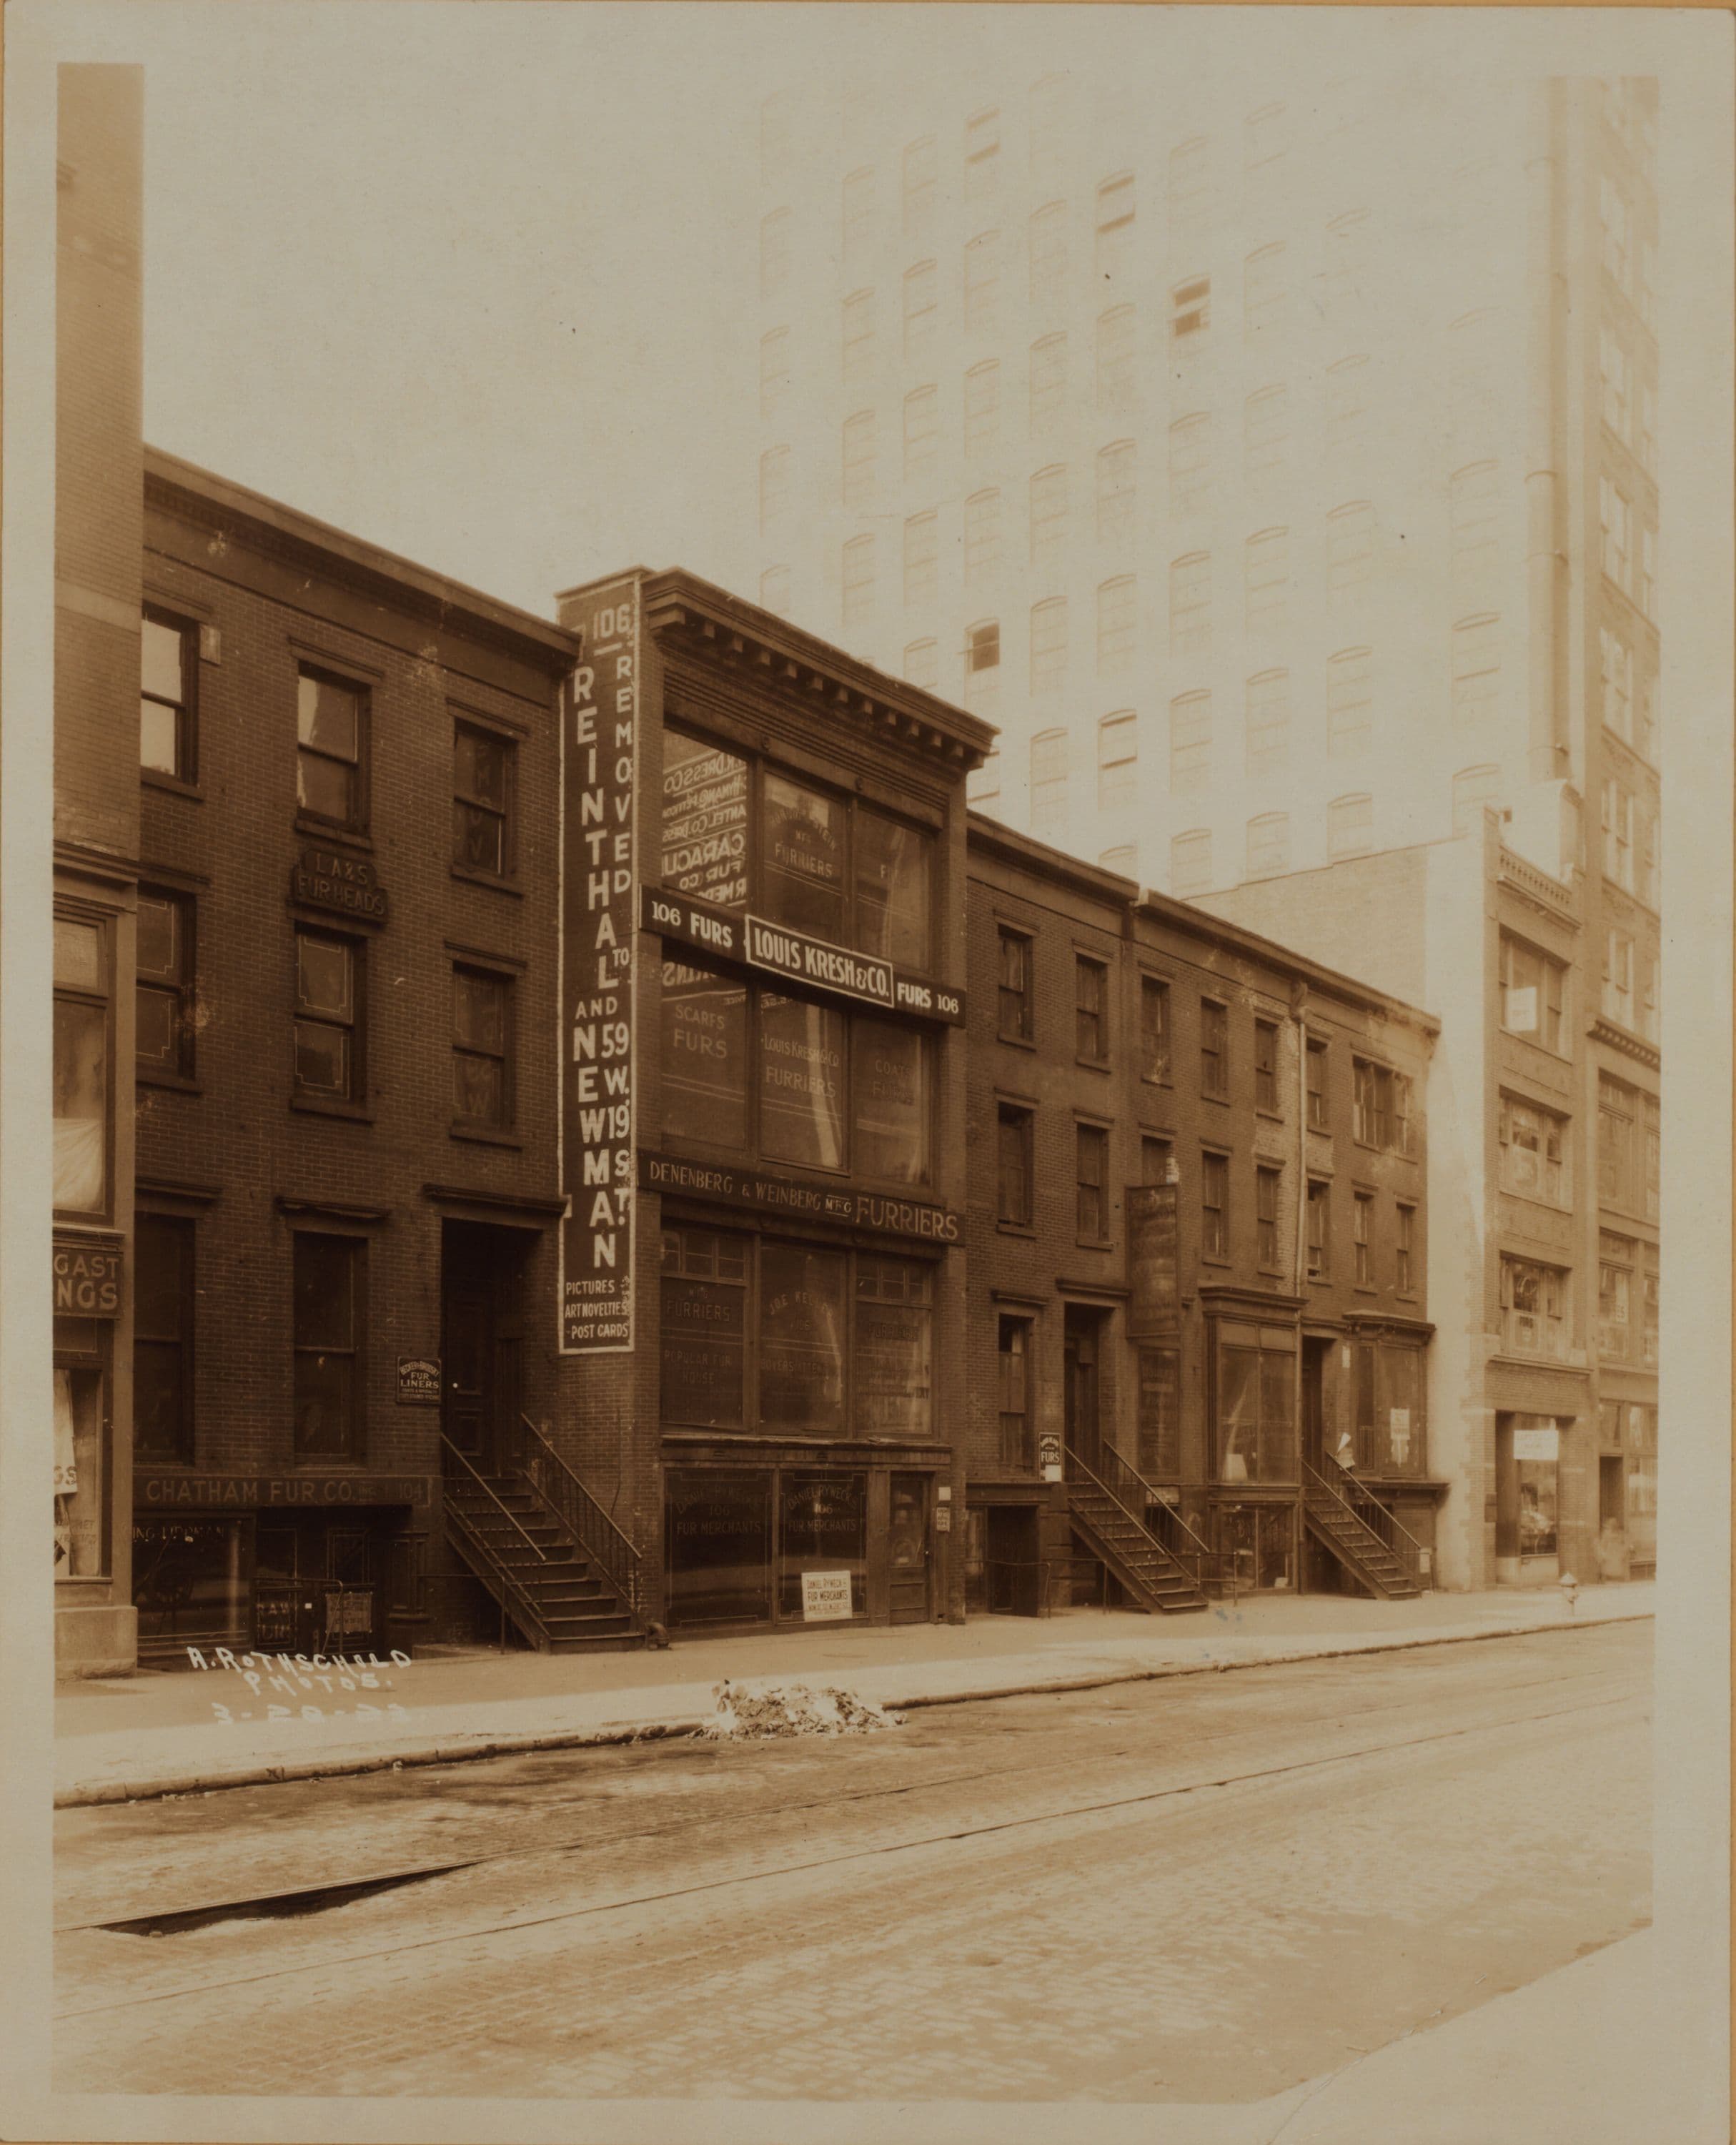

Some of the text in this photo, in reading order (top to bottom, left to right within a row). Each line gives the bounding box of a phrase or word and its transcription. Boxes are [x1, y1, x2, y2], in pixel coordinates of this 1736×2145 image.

[594, 605, 630, 640] 106
[614, 655, 633, 893] REMOVED
[652, 901, 732, 948] 106 FURS
[573, 665, 619, 1268] REINTHAL AND NEWMAN
[612, 947, 629, 967] TO
[755, 927, 800, 970] LOUIS
[805, 946, 855, 987] KRESH
[868, 966, 890, 996] CO.
[898, 981, 959, 1014] FURS 106
[675, 1005, 725, 1031] SCARFS
[602, 1022, 628, 1059] 59
[673, 1029, 728, 1059] FURS
[764, 1033, 790, 1056] LOUIS
[765, 1065, 836, 1098] FURRIERS
[650, 1159, 733, 1194] DENENBERG
[742, 1186, 749, 1197] &
[756, 1182, 820, 1211] WEINBERG
[855, 1196, 958, 1240] FURRIERS
[57, 1279, 118, 1309] NGS
[566, 1279, 615, 1295] PICTURES
[565, 1301, 628, 1319] ART NOVELTIES
[667, 1300, 731, 1321] FURRIERS
[572, 1322, 629, 1339] POST CARDS
[664, 1349, 709, 1365] POPULAR
[400, 1379, 439, 1389] LINERS
[411, 1372, 430, 1381] FUR
[1041, 1451, 1060, 1463] FURS
[146, 1480, 257, 1502] CHATHAM
[270, 1481, 314, 1502] FUR
[701, 1520, 762, 1535] MERCHANTS
